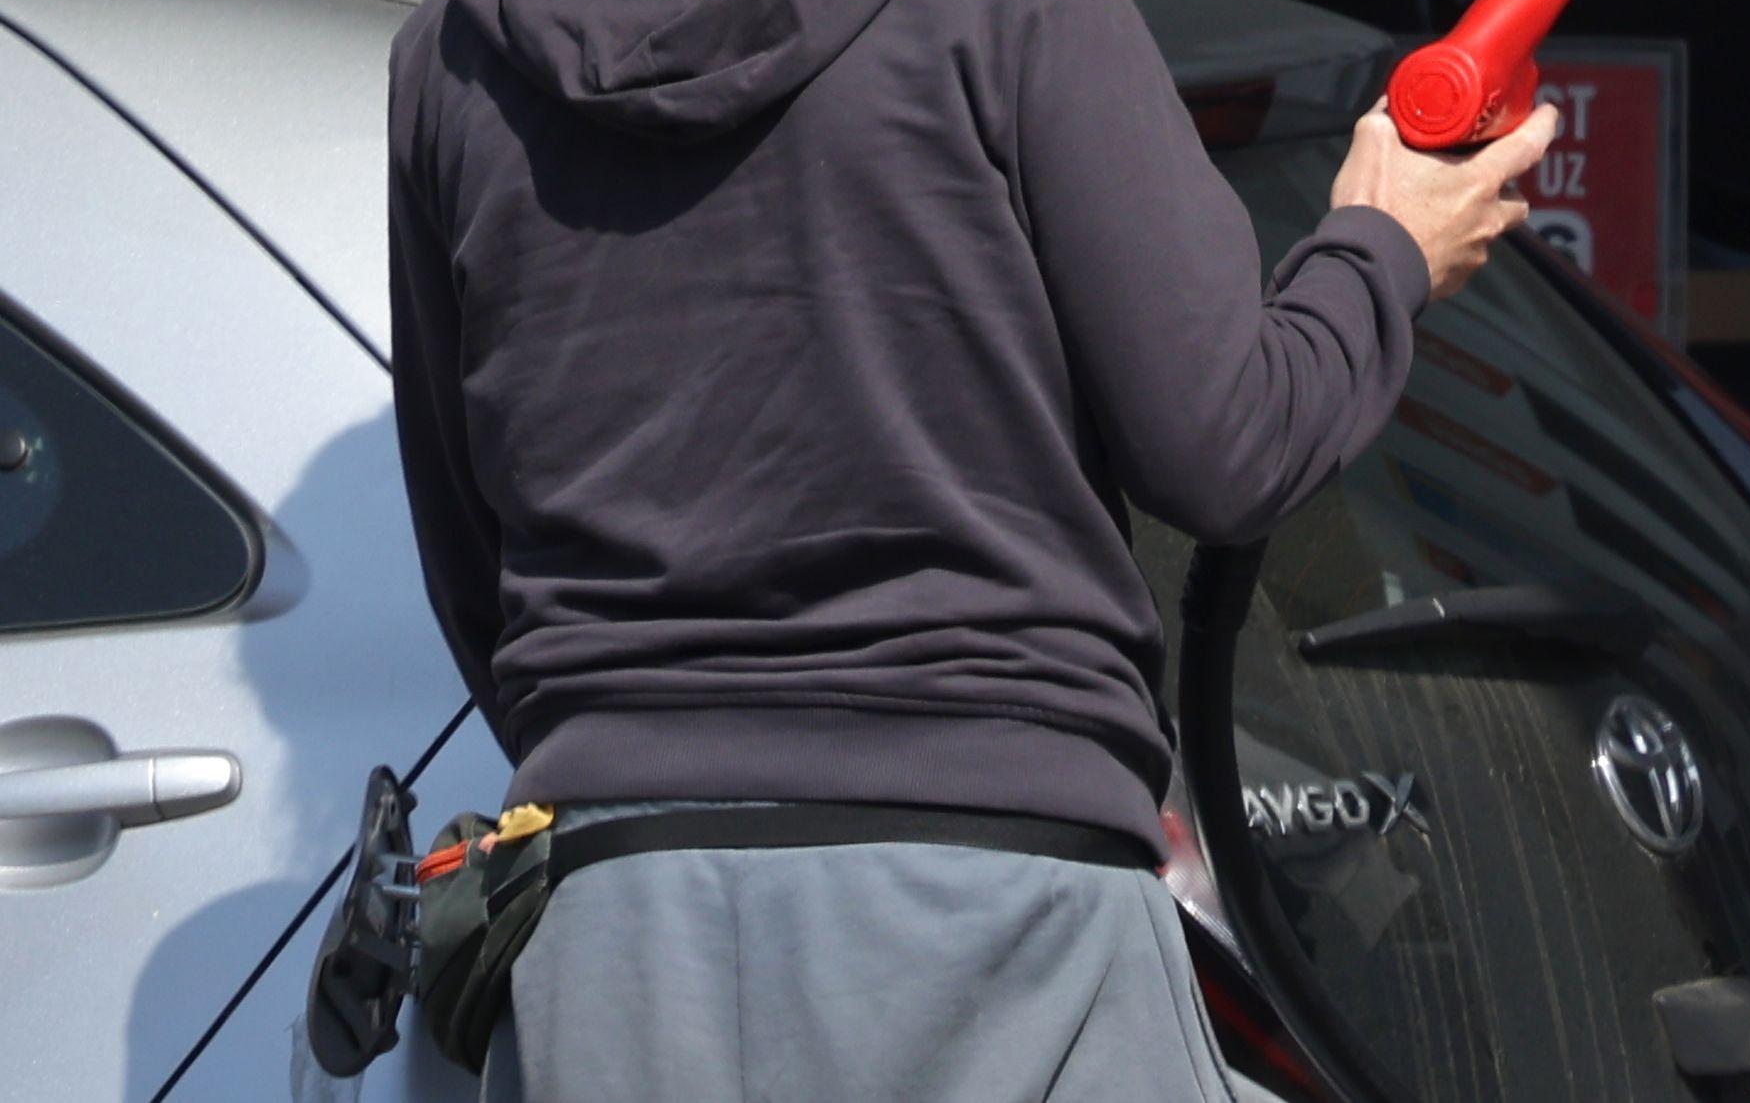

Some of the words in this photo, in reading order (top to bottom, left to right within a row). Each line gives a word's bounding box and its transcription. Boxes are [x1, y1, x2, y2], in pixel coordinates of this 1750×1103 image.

[1534, 84, 1597, 141] ST
[1538, 152, 1588, 197] UZ
[1242, 780, 1371, 836] AYGO
[1361, 771, 1431, 835] X
